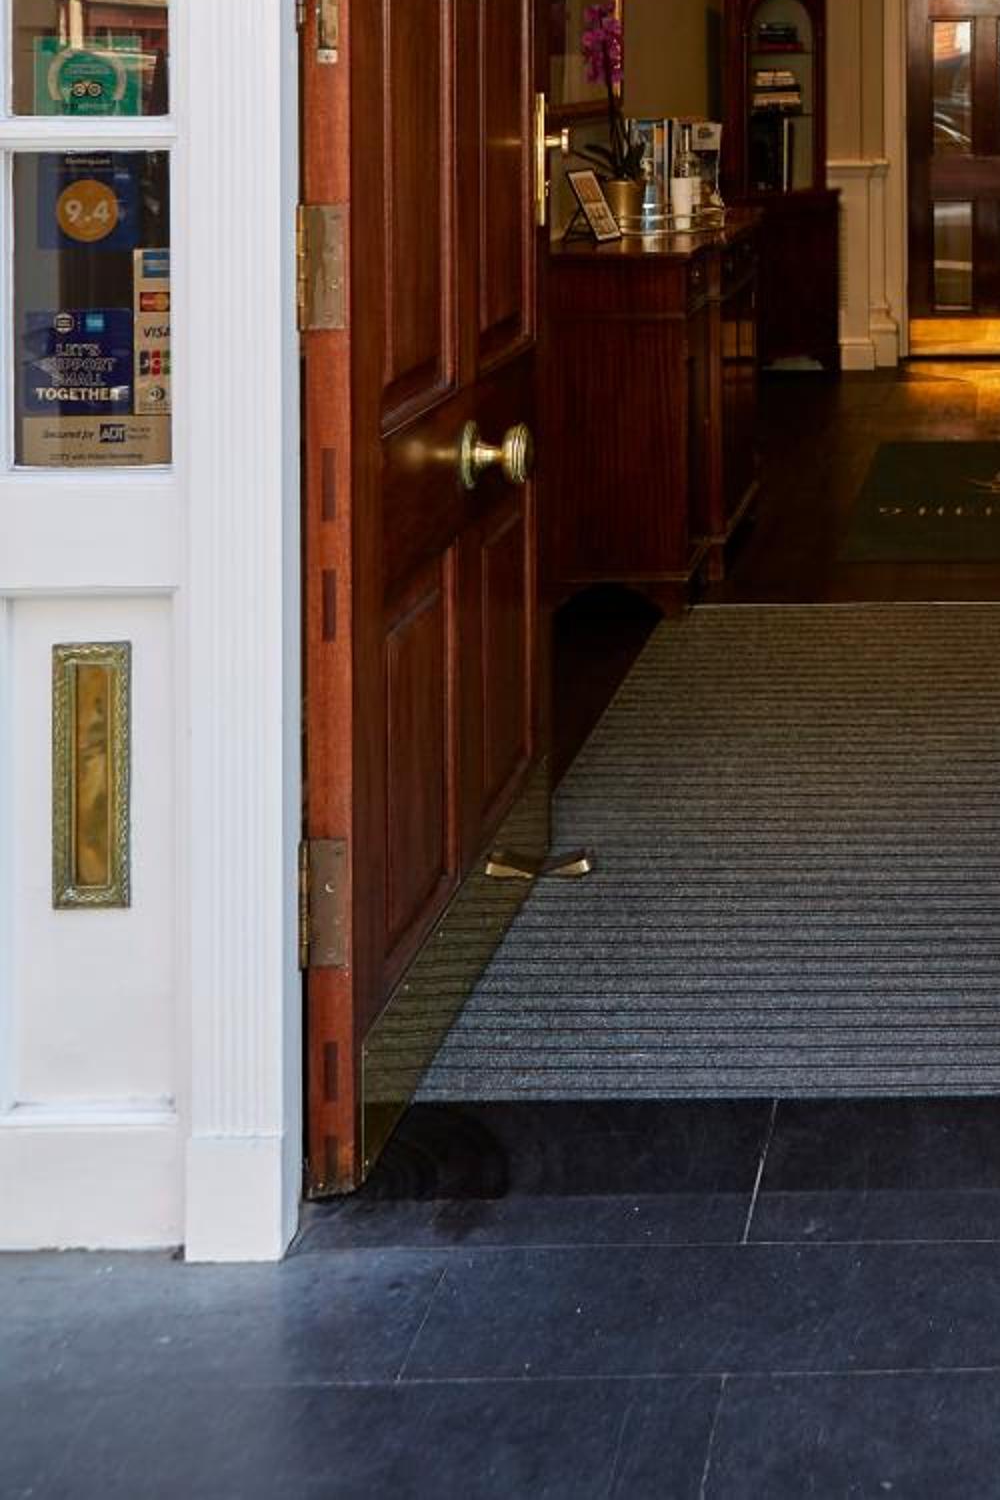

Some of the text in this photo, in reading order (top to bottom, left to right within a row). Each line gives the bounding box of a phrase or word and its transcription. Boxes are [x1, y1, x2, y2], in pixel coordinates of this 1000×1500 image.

[65, 199, 110, 226] 9.4
[56, 343, 102, 357] LET'S
[35, 387, 120, 401] TOGETHER
